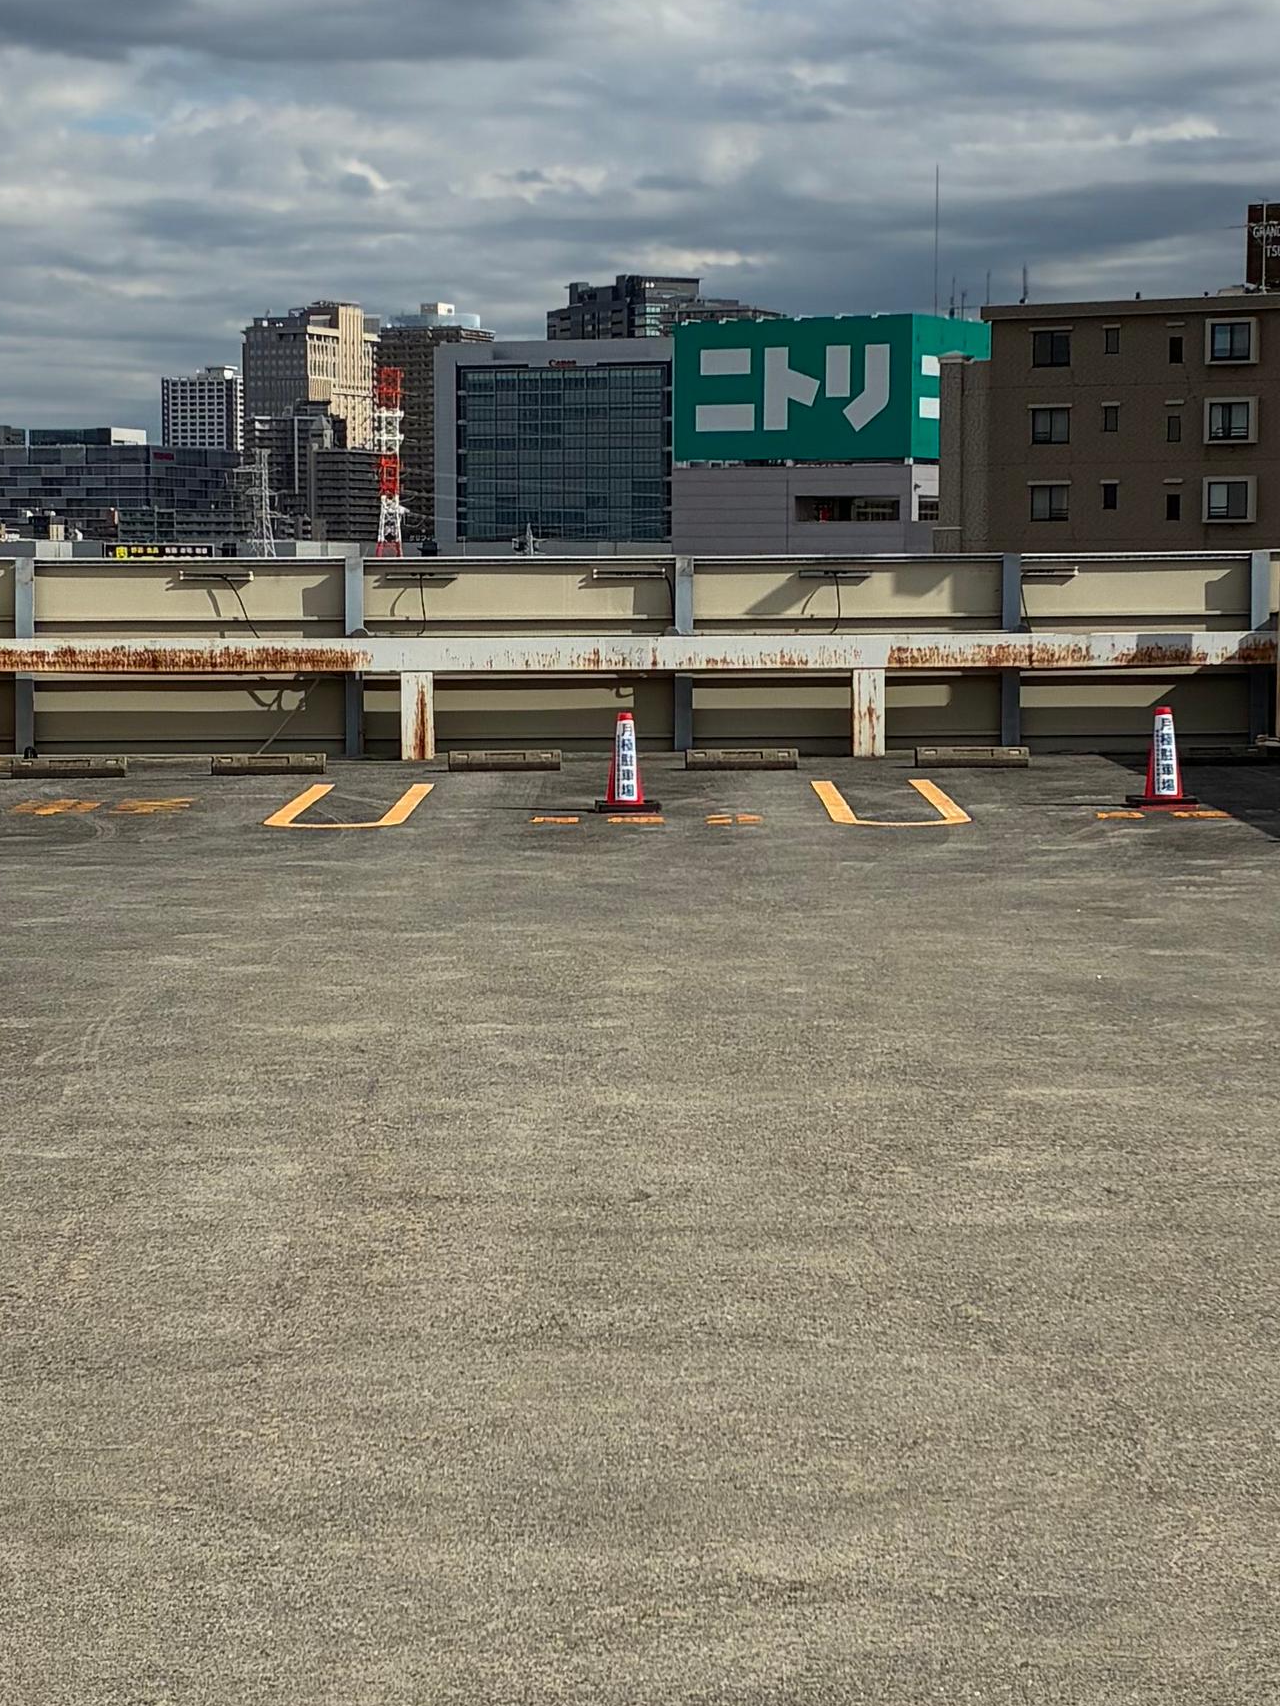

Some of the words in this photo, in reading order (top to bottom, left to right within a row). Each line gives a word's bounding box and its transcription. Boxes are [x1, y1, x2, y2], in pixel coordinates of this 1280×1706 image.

[696, 344, 891, 432] ニトリ
[621, 722, 635, 798] 月極駐車場
[1160, 717, 1176, 793] 月極駐車場
